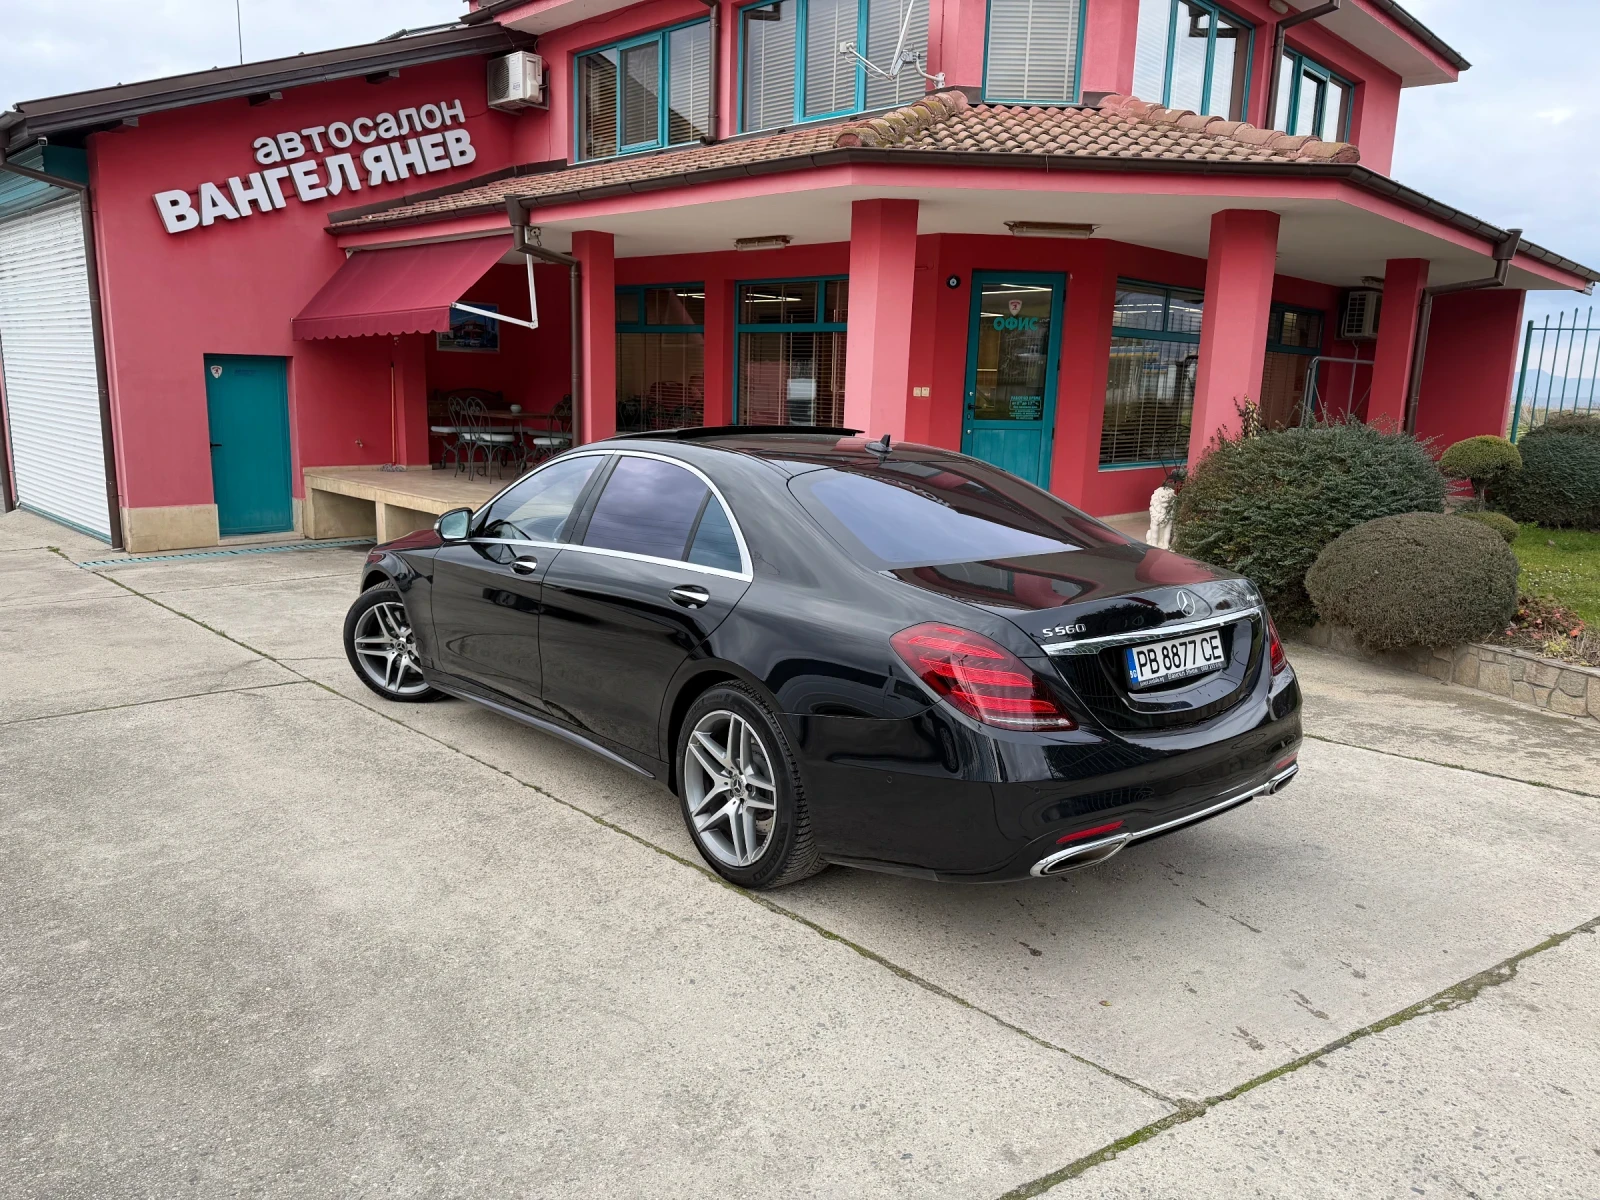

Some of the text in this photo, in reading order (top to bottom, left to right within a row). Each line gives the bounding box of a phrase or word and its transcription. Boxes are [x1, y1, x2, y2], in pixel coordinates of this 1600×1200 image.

[253, 99, 466, 165] автосалон
[152, 128, 477, 234] ВАНГЕЛ ЯНЕВ
[993, 316, 1038, 331] ОФИС
[1042, 623, 1087, 638] S 560
[1136, 635, 1222, 677] PB 8877 CE
